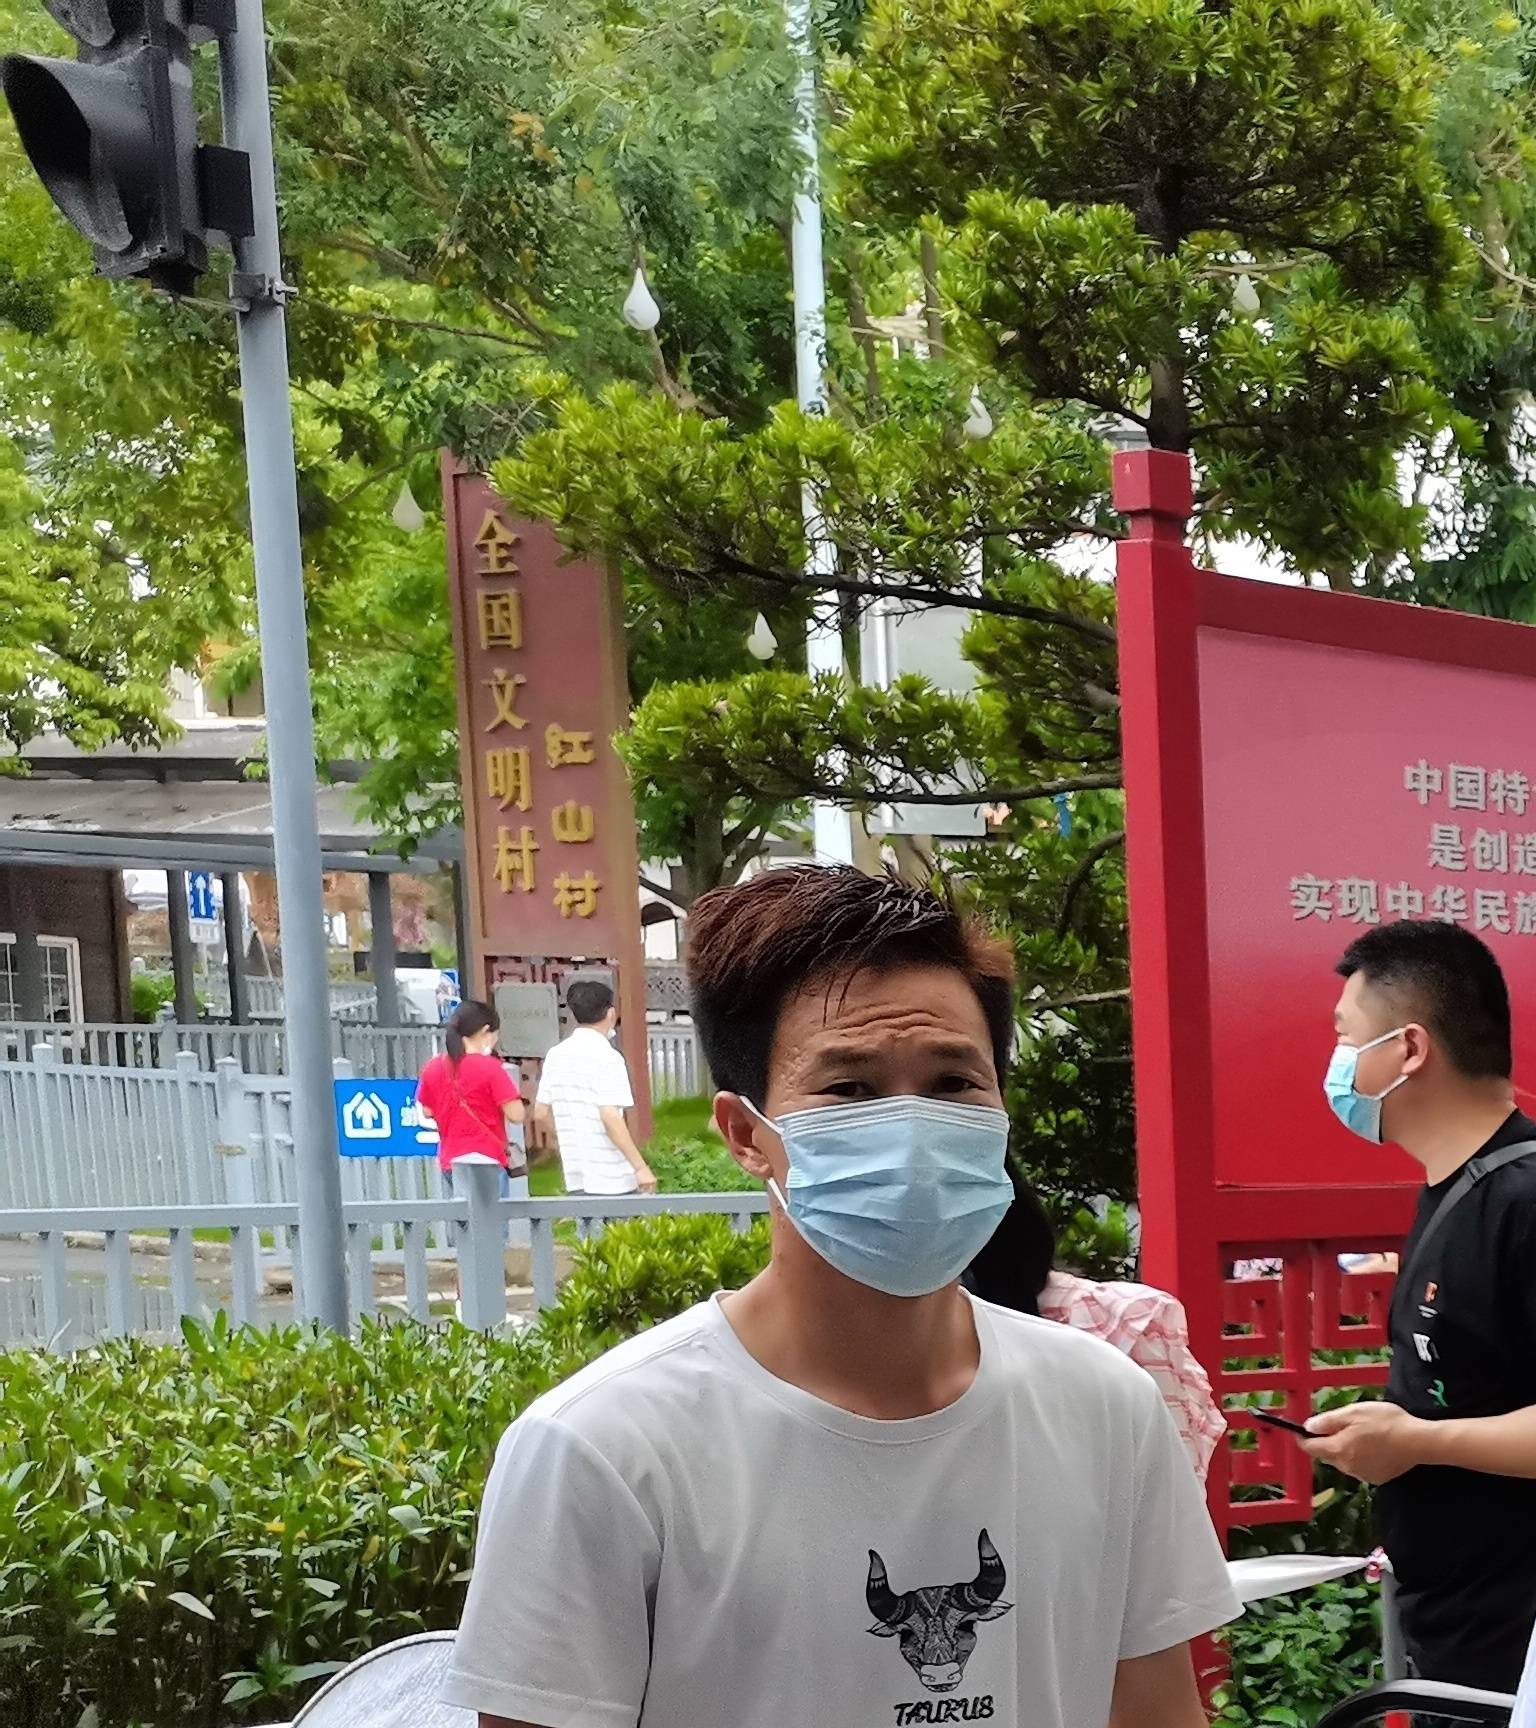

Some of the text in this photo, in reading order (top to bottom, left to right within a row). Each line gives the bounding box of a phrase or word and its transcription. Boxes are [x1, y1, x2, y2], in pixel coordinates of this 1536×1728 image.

[474, 509, 540, 894] 全国文明村
[545, 722, 603, 919] 红山村
[894, 1695, 994, 1727] TAURUS
